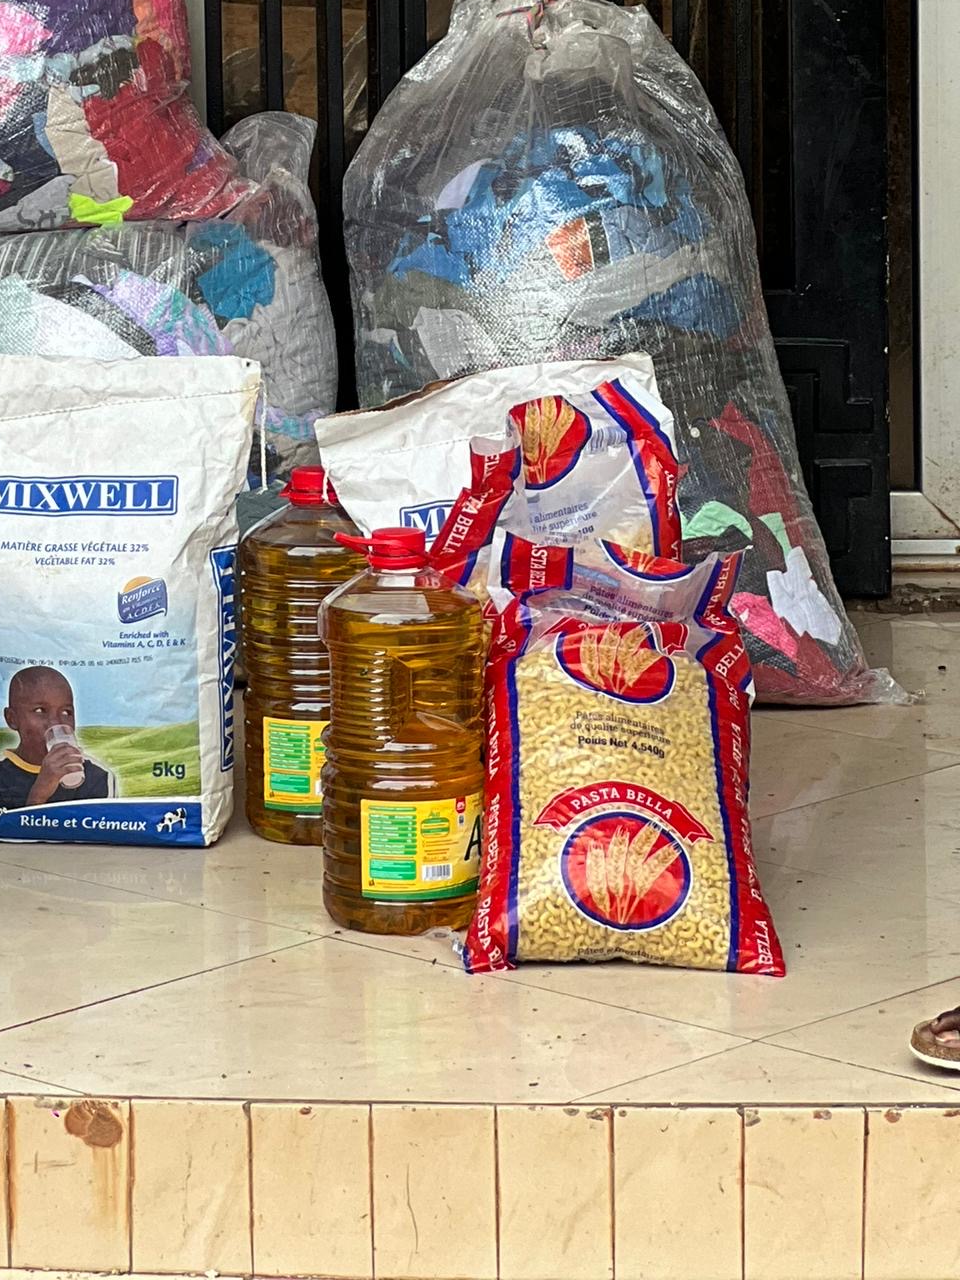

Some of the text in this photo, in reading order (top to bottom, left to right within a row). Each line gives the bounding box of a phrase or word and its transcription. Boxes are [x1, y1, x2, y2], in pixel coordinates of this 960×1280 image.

[534, 501, 590, 523] alimentaires
[442, 515, 474, 554] BELLA
[0, 541, 150, 553] MATIÈRE GRASSE VÉGÉTALE 32%
[81, 556, 96, 566] FAT
[98, 557, 116, 566] 32%
[617, 591, 674, 618] alimentaires
[102, 638, 187, 649] Vitamins E K
[119, 630, 169, 640] Enriched with
[570, 721, 582, 731] de
[606, 713, 665, 735] alimentaires
[609, 737, 628, 749] Net
[631, 741, 665, 759] 4.540g
[151, 761, 186, 780] 5kg
[570, 787, 673, 820] PASTA BELLA
[20, 814, 148, 832] Riche et Crémeux
[477, 896, 492, 951] PASTA
[755, 919, 772, 966] BELLA
